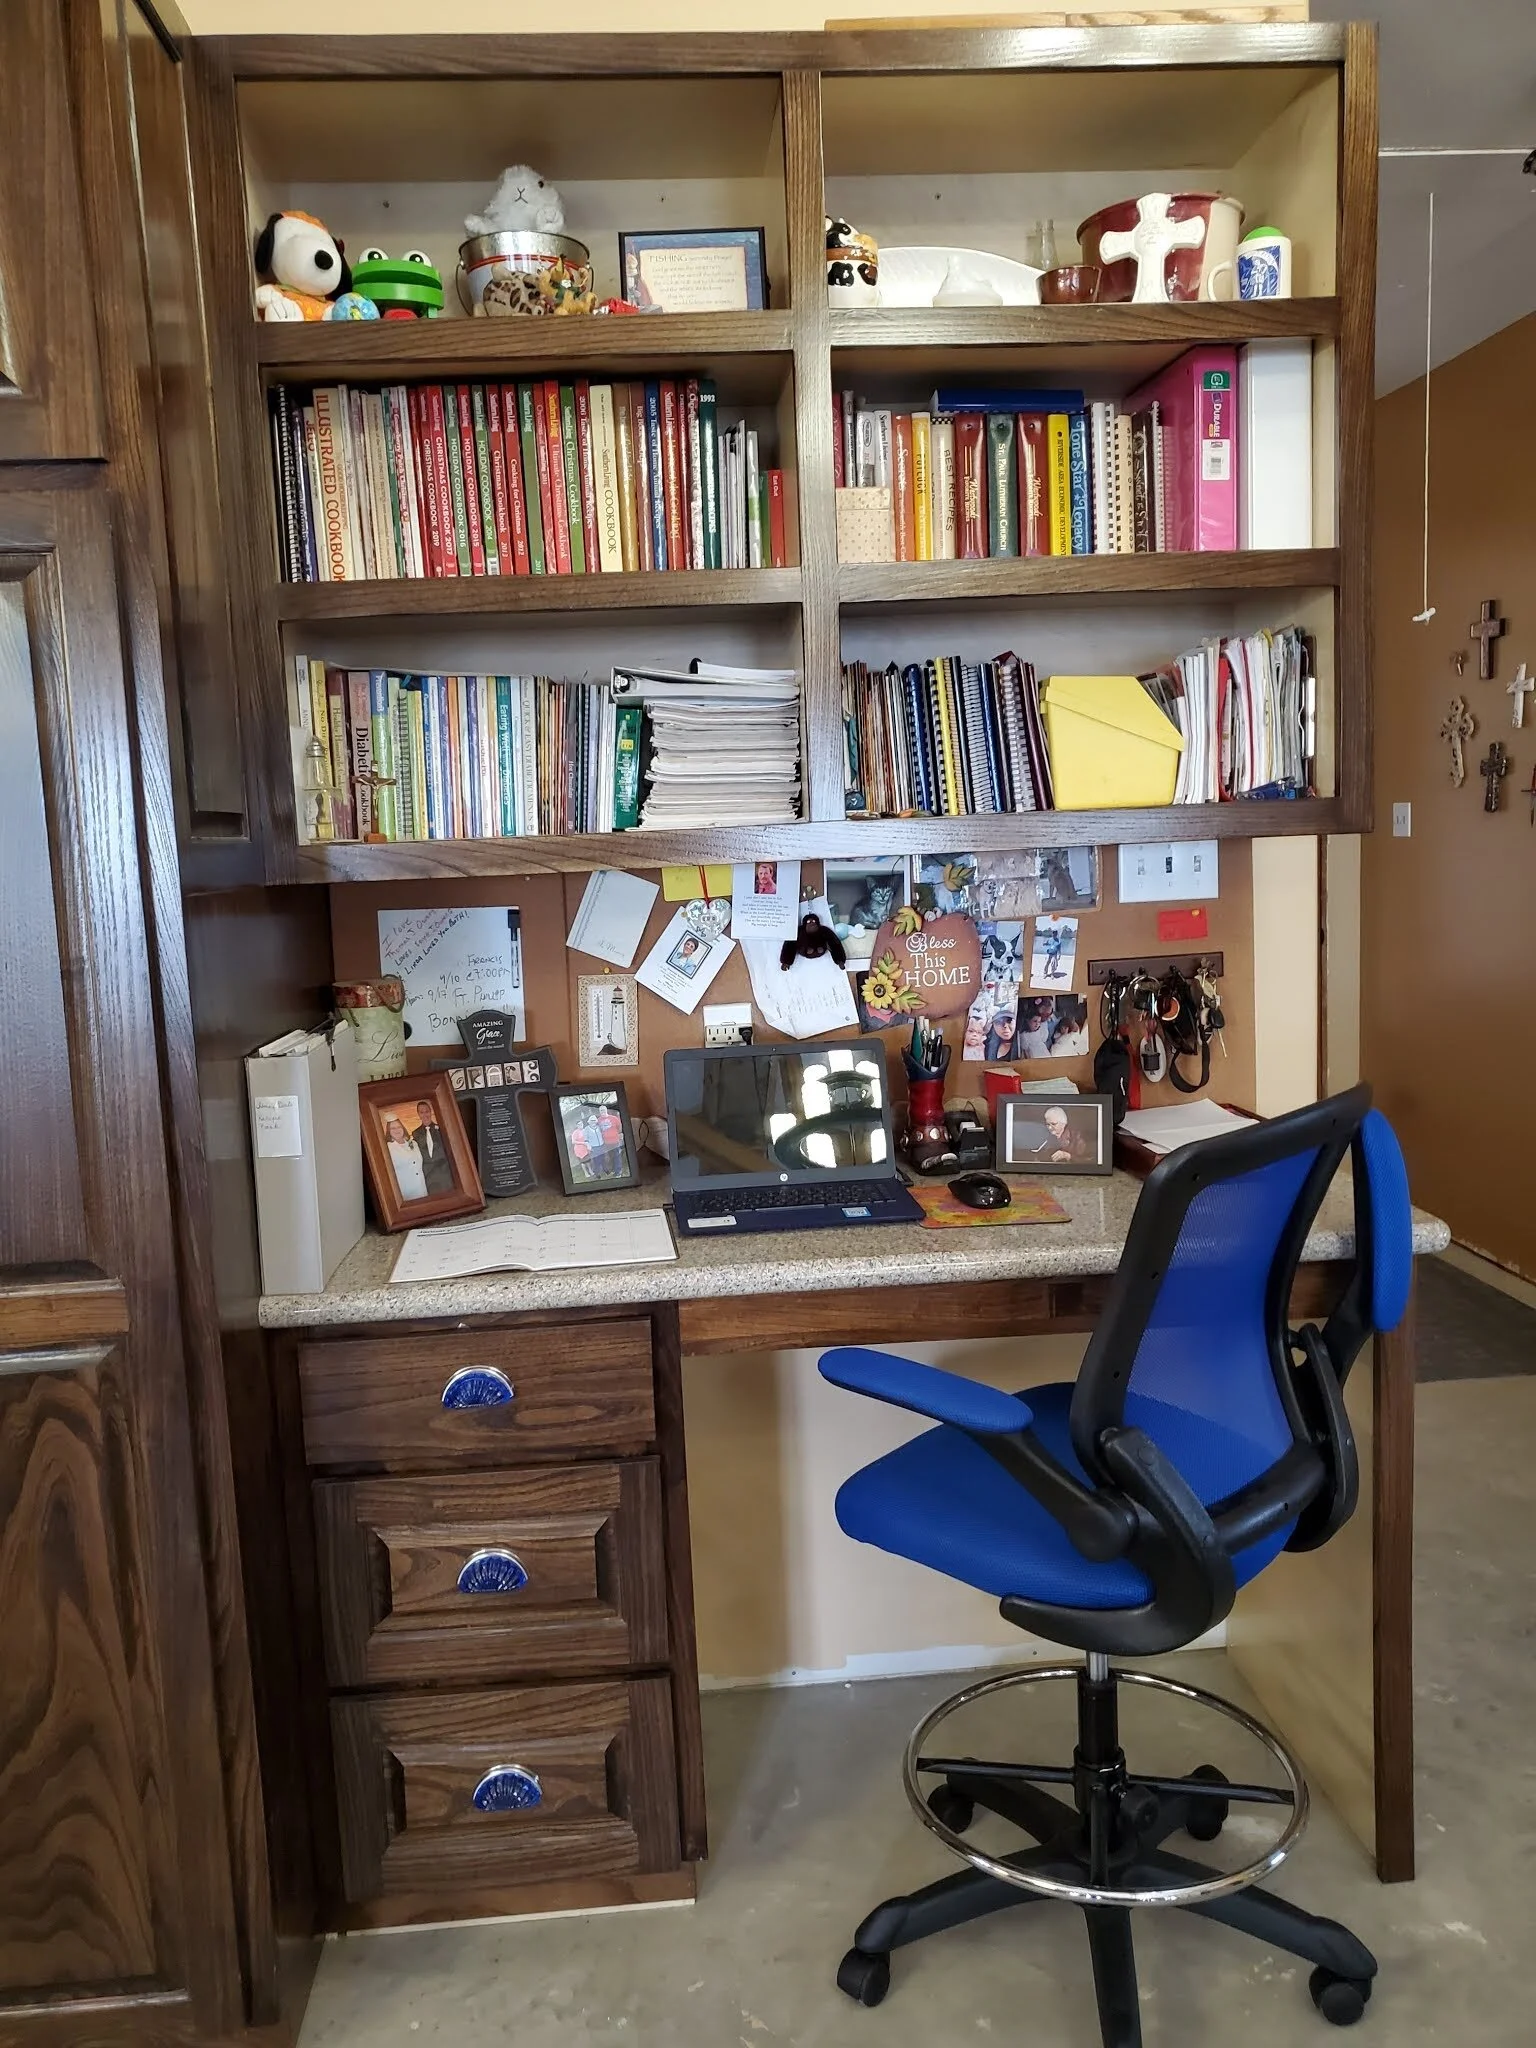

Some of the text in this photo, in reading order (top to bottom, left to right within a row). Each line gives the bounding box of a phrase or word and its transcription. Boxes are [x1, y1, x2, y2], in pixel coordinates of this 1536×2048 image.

[664, 391, 673, 418] Southern
[700, 394, 715, 402] 1992
[394, 414, 402, 453] Gooseberry
[536, 405, 544, 435] Christmas
[666, 418, 674, 436] Living
[879, 415, 888, 441] Southern
[1213, 404, 1222, 437] DURABLE
[397, 454, 405, 474] Patch
[423, 439, 433, 481] CHRISTMAS
[478, 440, 488, 473] HOLIDAY
[493, 450, 502, 490] Christmas
[552, 444, 561, 478] Ultimate
[566, 442, 575, 483] Christmas
[582, 449, 590, 469] Home
[649, 397, 664, 528] 2005 Taste of Home Annual Recipes
[897, 449, 908, 491] Secrets
[916, 454, 927, 495] POTLUCK
[998, 458, 1006, 477] PAUL
[316, 395, 345, 581] ILLUSTRATED COOKBOOK
[399, 475, 408, 510] Christmas
[435, 437, 453, 555] CHRISTMAS COOKBOOK 2017
[451, 438, 466, 547] HOLIDAY COOKBOOK 2016
[464, 438, 480, 547] HOLIDAY COOKBOOK 2015
[481, 475, 492, 521] COOKBOOK
[509, 459, 518, 488] Cooking
[514, 501, 522, 534] Christmas
[555, 479, 564, 518] Christmas
[583, 472, 592, 499] Annual
[602, 449, 617, 554] Southern Living COOKBOOK
[944, 450, 955, 531] BEST RECIPES
[999, 479, 1007, 517] LUTHERAN
[1071, 421, 1087, 551] Lone Star Legacy
[1128, 478, 1132, 492] OF
[426, 483, 437, 527] COOKBOOK
[496, 492, 506, 533] Cookbook
[569, 484, 579, 525] Cookbook
[585, 501, 593, 529] Recipes
[670, 498, 680, 539] Cooking
[708, 501, 716, 533] RECIPES
[558, 520, 567, 559] Cookbook
[999, 519, 1008, 551] CHURCH
[499, 705, 509, 730] Eating
[522, 701, 531, 725] QUICK
[332, 707, 344, 768] Healthy Homestyle
[501, 732, 509, 751] Well
[525, 755, 533, 793] DIABETIC
[905, 932, 957, 953] Bless
[910, 952, 946, 970] This
[904, 966, 971, 989] HOME
[473, 1020, 503, 1028] AMAZING
